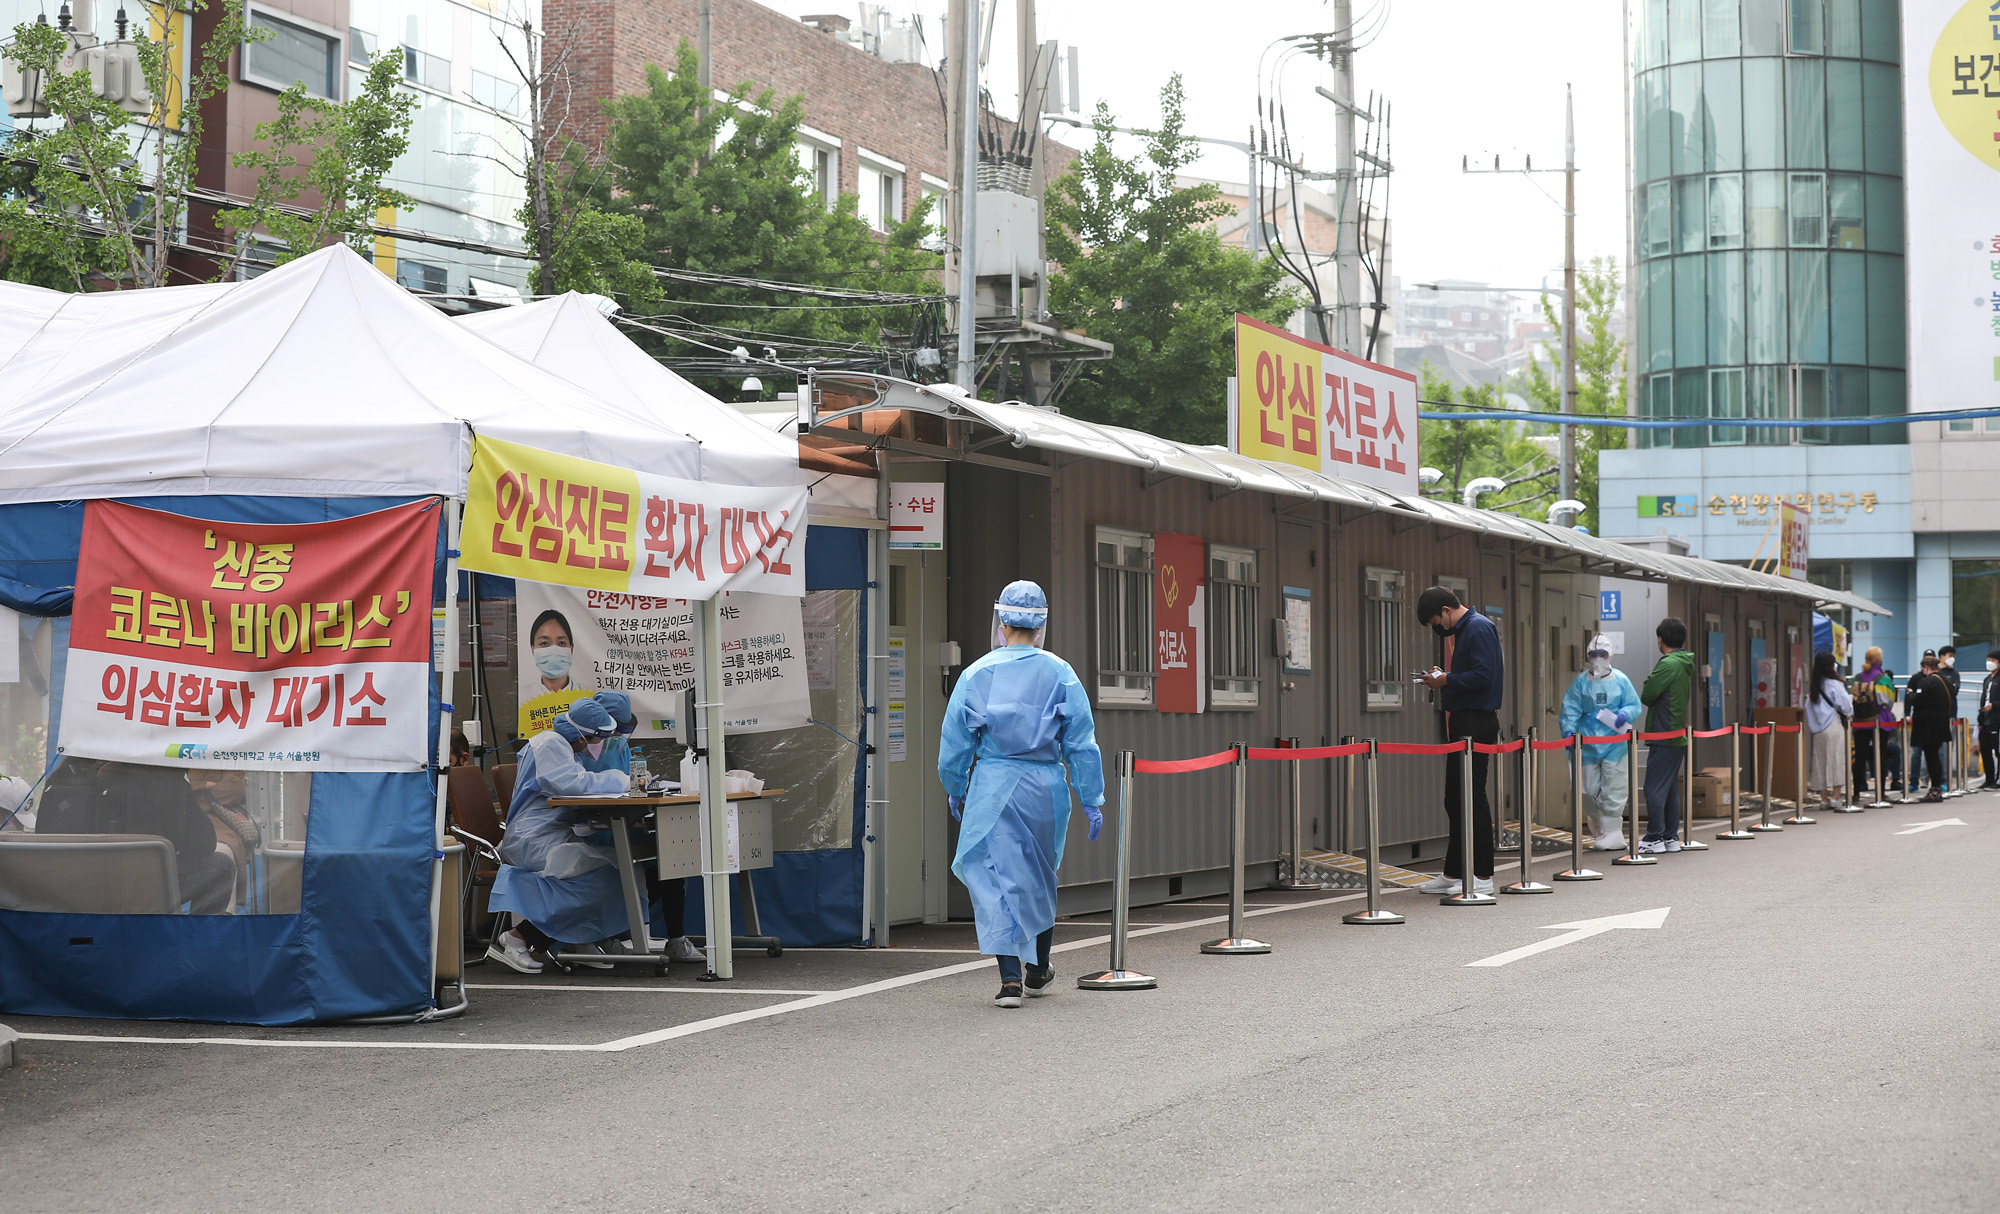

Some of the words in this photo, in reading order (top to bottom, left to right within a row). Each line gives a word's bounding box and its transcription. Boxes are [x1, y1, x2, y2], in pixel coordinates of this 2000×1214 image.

[1256, 350, 1318, 457] 안심
[1325, 372, 1406, 476] 진료소
[907, 496, 936, 514] 수납
[1661, 501, 1698, 518] SCH
[491, 469, 630, 572] 안심진료
[643, 495, 709, 582] 환자
[1817, 516, 1847, 526] Center
[106, 586, 216, 654] 코로나
[619, 617, 640, 631] 전용
[630, 629, 691, 647] 기다려주세요.
[655, 649, 669, 661] 경우
[669, 648, 688, 659] KF94
[746, 647, 795, 666] 착용하세요.
[1158, 628, 1188, 670] 진료소
[593, 661, 602, 673] 2.
[604, 661, 635, 676] 대기실
[734, 666, 784, 685] 유지하세요.
[597, 677, 605, 689] 3.
[605, 676, 623, 690] 대기
[625, 679, 666, 692] 환자끼리
[97, 664, 256, 730] 의심환자
[266, 672, 387, 729] 대기소
[531, 719, 545, 731] 코와
[212, 750, 265, 761] 순천향대학교
[268, 751, 284, 761] 부속
[286, 750, 320, 762] 서울병원
